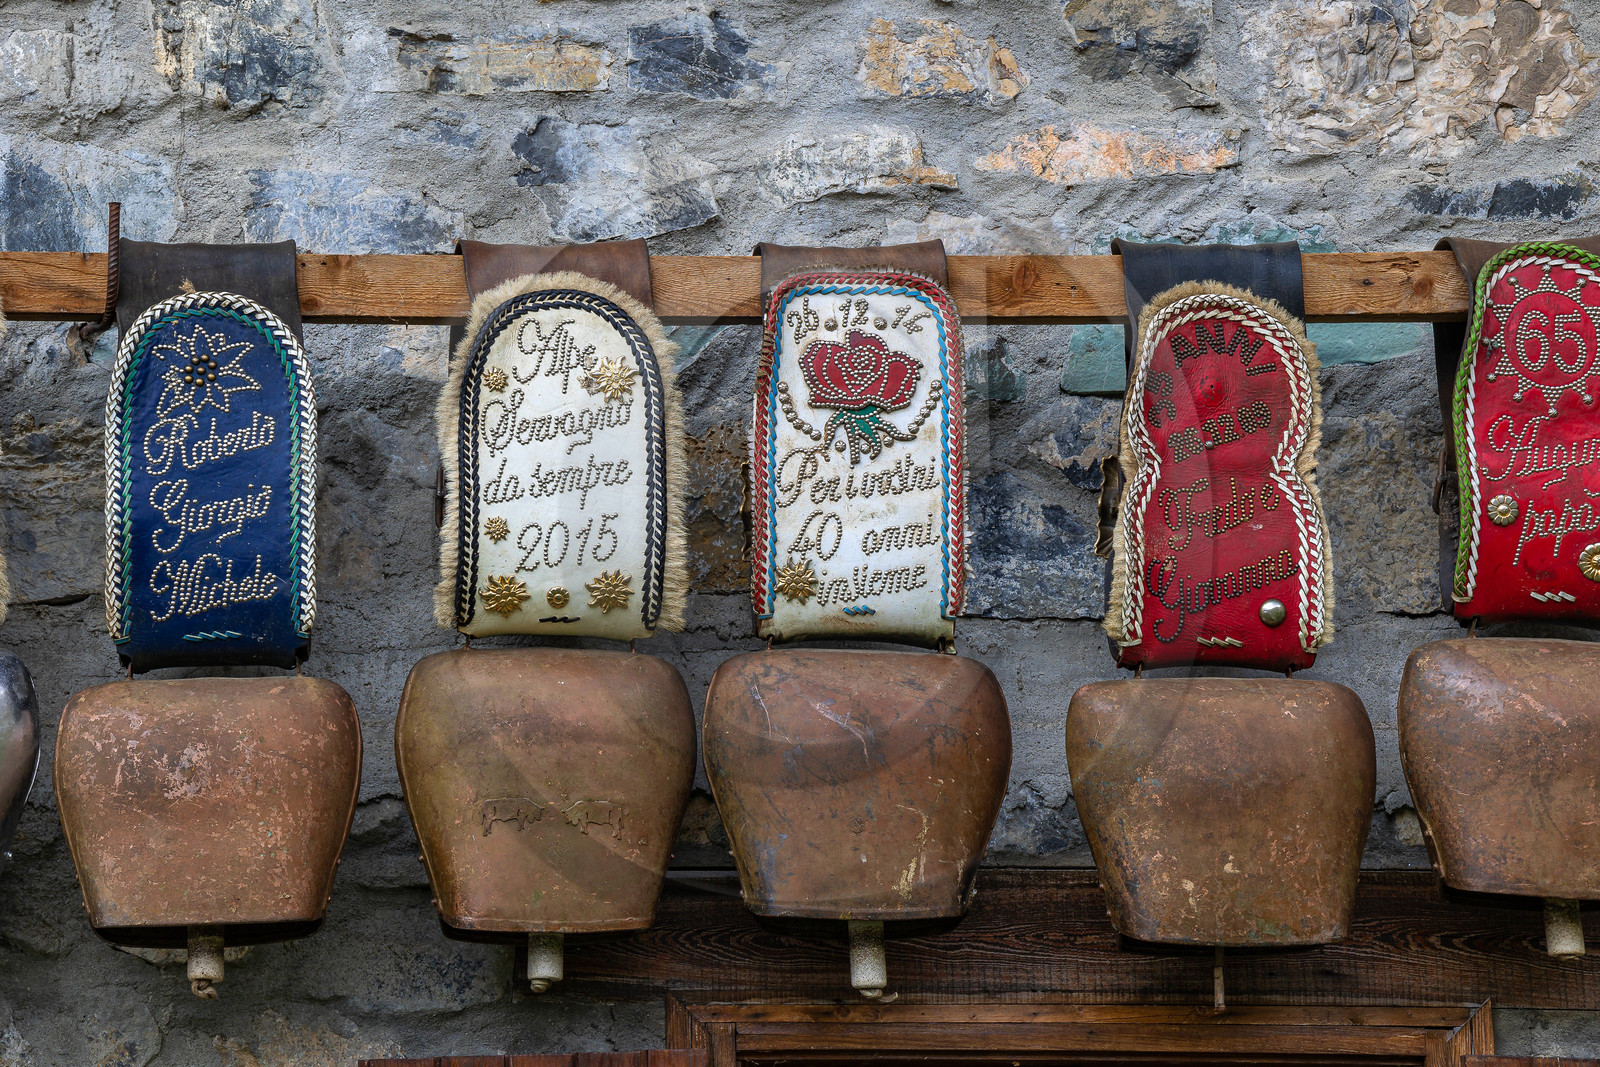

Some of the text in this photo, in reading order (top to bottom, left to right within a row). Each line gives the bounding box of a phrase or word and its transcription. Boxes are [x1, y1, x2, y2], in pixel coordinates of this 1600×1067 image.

[511, 317, 599, 395] Alpe
[1170, 322, 1277, 377] ANNI
[1515, 309, 1587, 374] 65
[144, 411, 276, 476] Roberto
[483, 453, 633, 510] da sempre
[775, 446, 843, 508] Per
[860, 453, 941, 499] vostri
[149, 479, 273, 554] Giorgio
[514, 512, 619, 573] 2015
[787, 510, 941, 562] 40 anni
[1158, 477, 1280, 552] Fredo e
[149, 553, 279, 622] Michele
[816, 563, 928, 607] insieme
[1147, 549, 1300, 644] Giovanna
